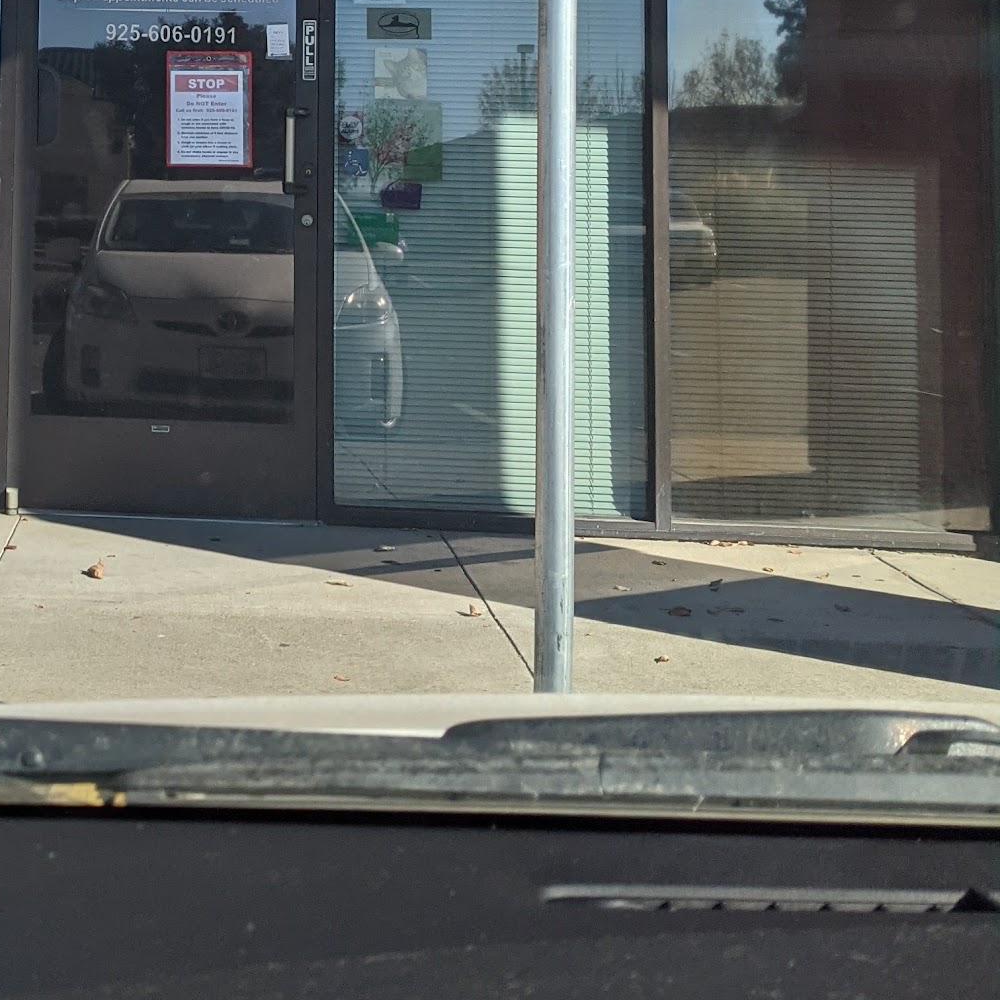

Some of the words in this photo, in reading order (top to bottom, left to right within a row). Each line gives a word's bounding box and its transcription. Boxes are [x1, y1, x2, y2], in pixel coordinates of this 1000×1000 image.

[105, 24, 237, 45] 925-606-0191
[305, 25, 315, 66] PULL
[188, 78, 225, 89] STOP
